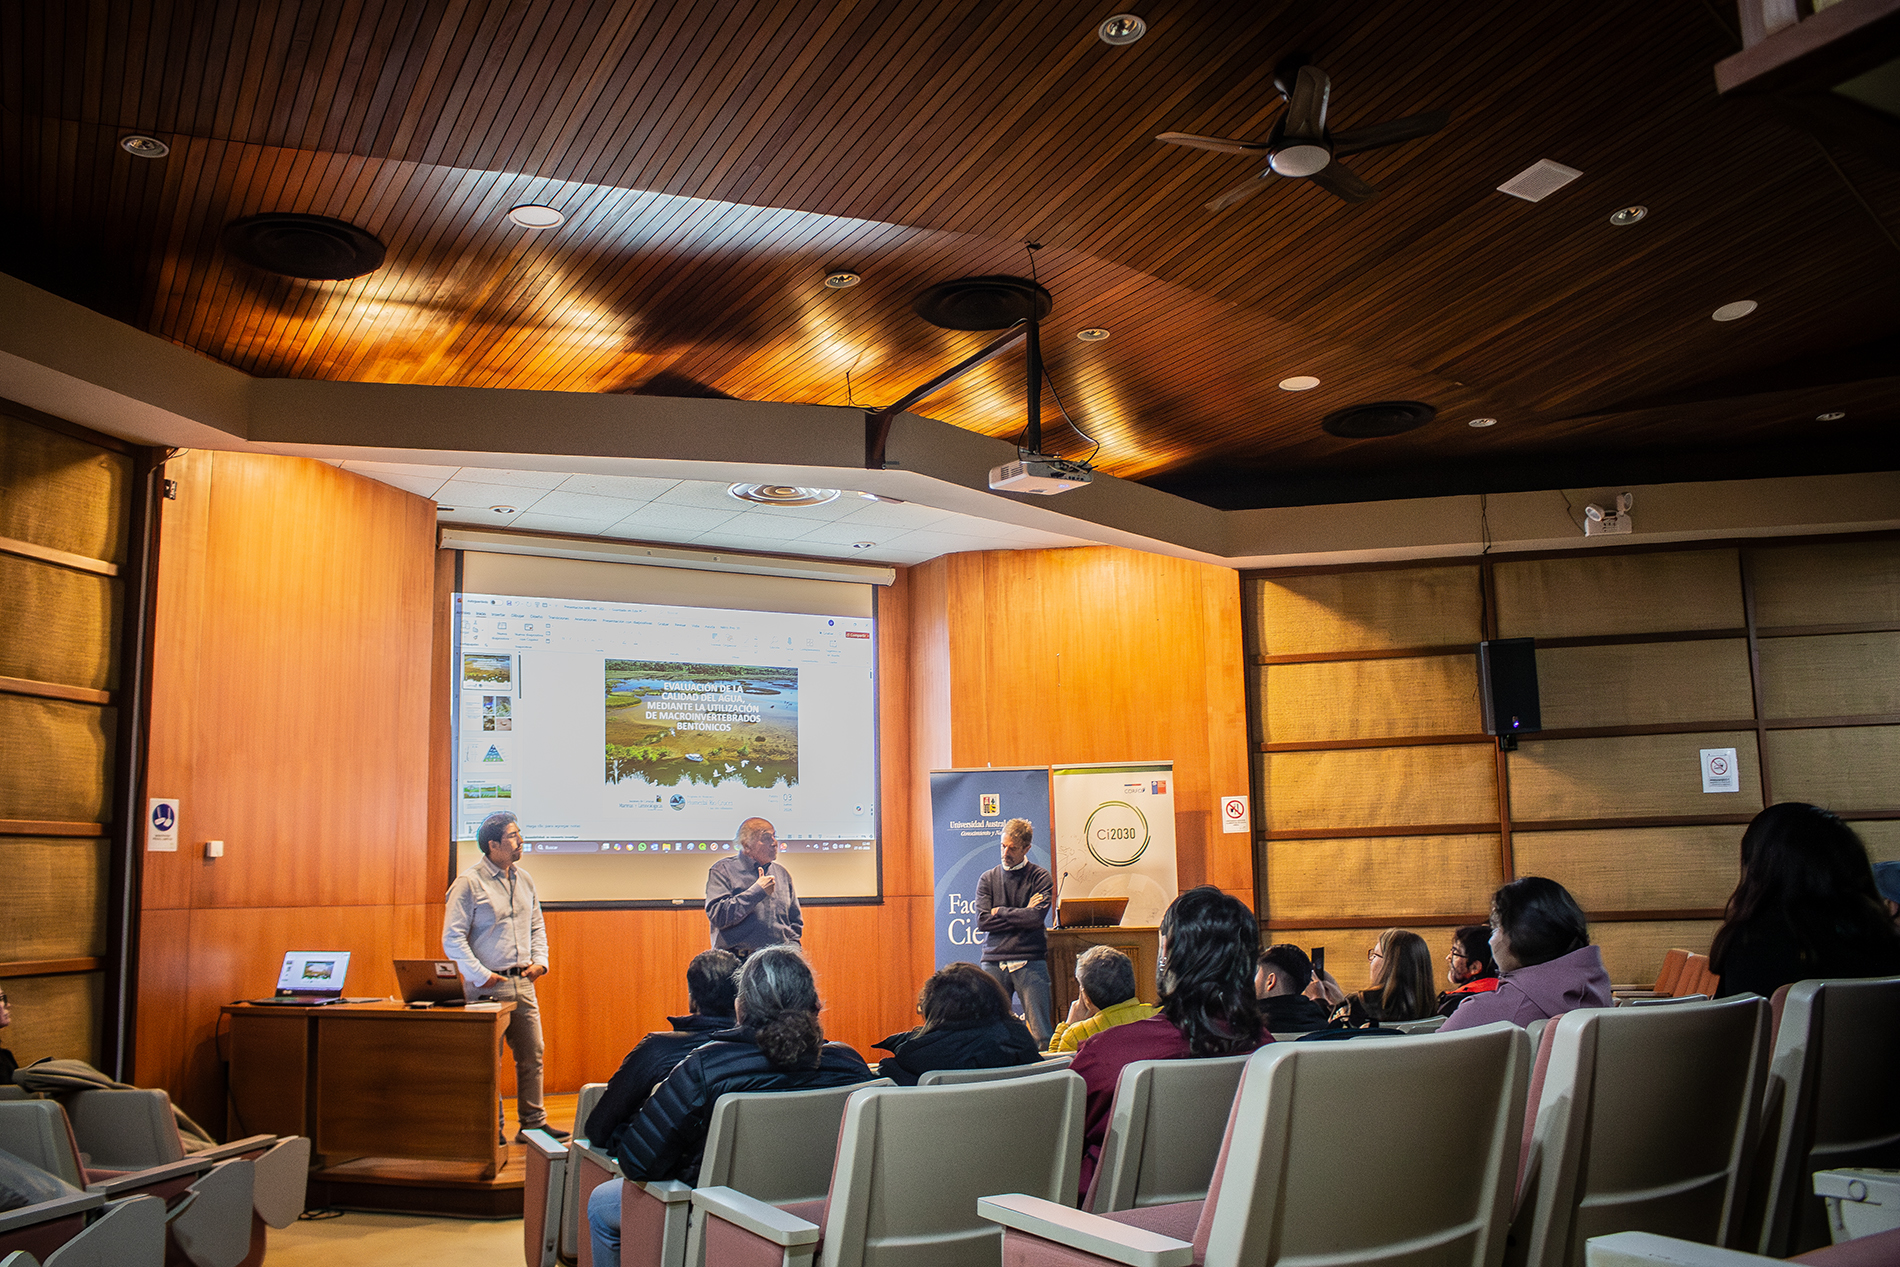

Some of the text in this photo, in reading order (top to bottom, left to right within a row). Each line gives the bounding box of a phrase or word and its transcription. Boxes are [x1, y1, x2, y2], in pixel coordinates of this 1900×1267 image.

[663, 682, 744, 693] EVALUACIÓN DE LA
[661, 692, 746, 704] CALIDAD DEL AGUA,
[647, 701, 760, 713] MEDIANTE LA UTILIZACIÓN
[645, 711, 761, 723] DE MACROINVERTEBRADOS
[676, 721, 732, 732] BENTÓNICOS
[949, 819, 1006, 829] Universidad Austral
[1096, 827, 1136, 840] Ci2030
[947, 918, 985, 945] Cie
